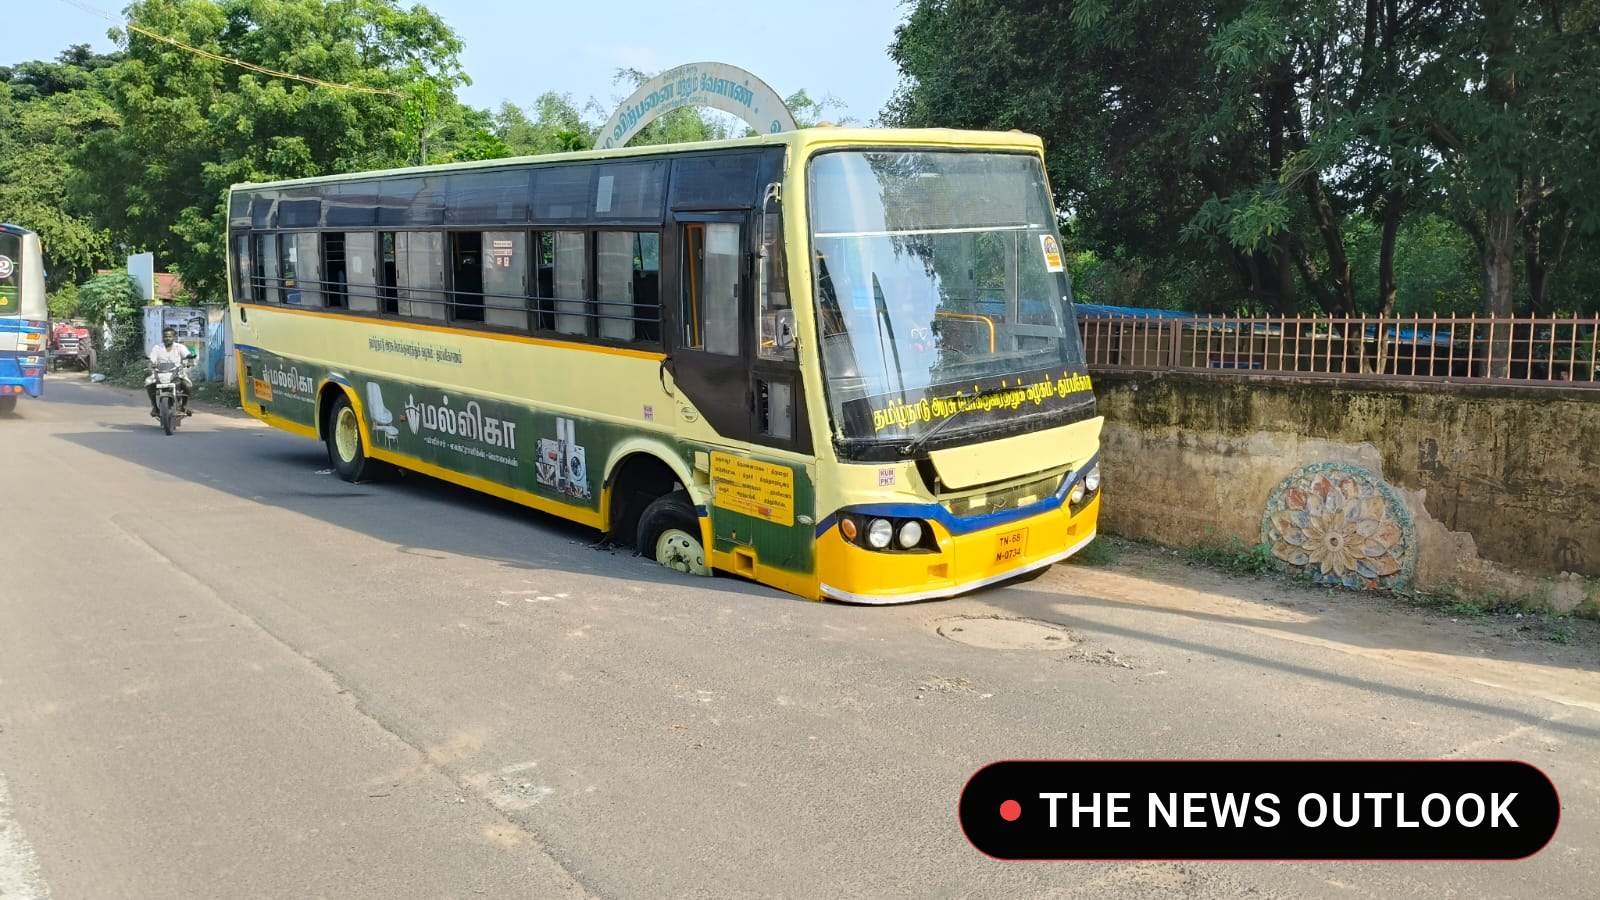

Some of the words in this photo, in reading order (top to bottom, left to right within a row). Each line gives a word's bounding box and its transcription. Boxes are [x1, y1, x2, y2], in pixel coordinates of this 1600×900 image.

[421, 395, 516, 449] மல்லிகா
[874, 398, 930, 433] தமிழ்நாடு
[932, 398, 957, 418] அரசு
